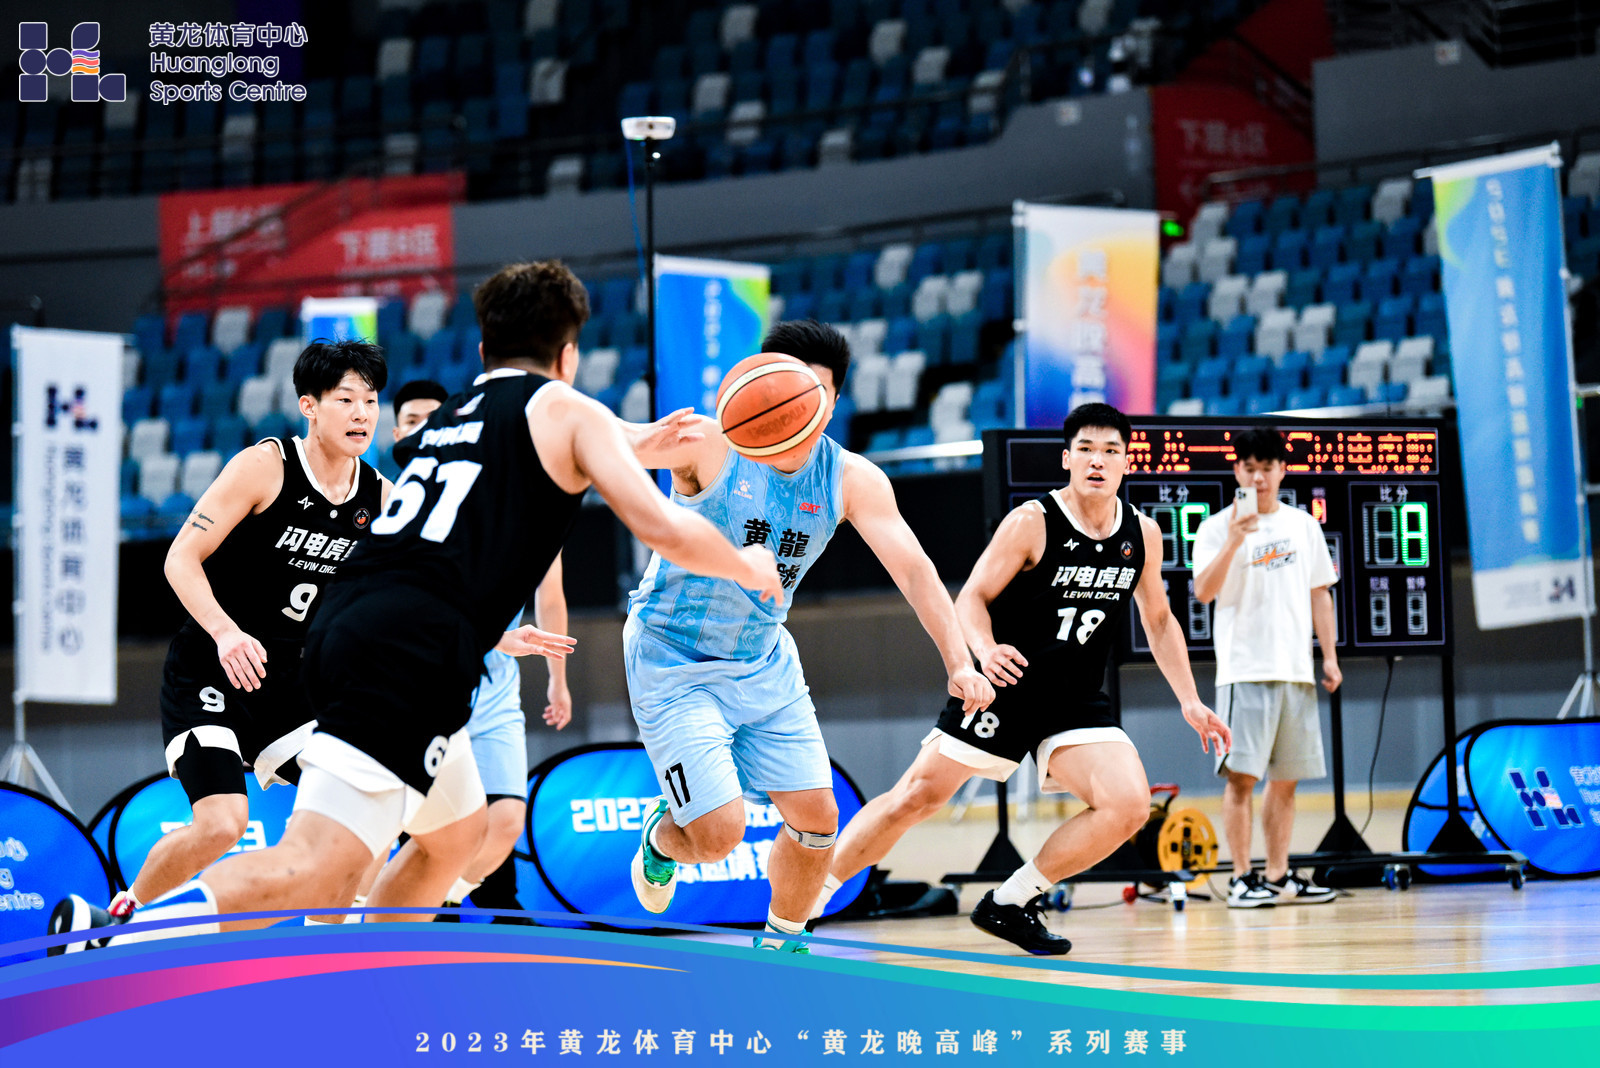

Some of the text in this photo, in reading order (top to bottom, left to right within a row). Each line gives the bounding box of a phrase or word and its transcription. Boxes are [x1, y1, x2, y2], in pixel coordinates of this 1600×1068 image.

[1379, 484, 1409, 503] 比分
[288, 557, 318, 572] LEVIN
[1051, 566, 1136, 590] 闪电虎鲸
[281, 583, 318, 622] 9
[1063, 590, 1093, 599] LEVIN
[1056, 606, 1106, 645] 18
[199, 686, 225, 713] 9
[424, 735, 449, 778] 6
[664, 762, 691, 808] 17
[570, 797, 648, 833] 202
